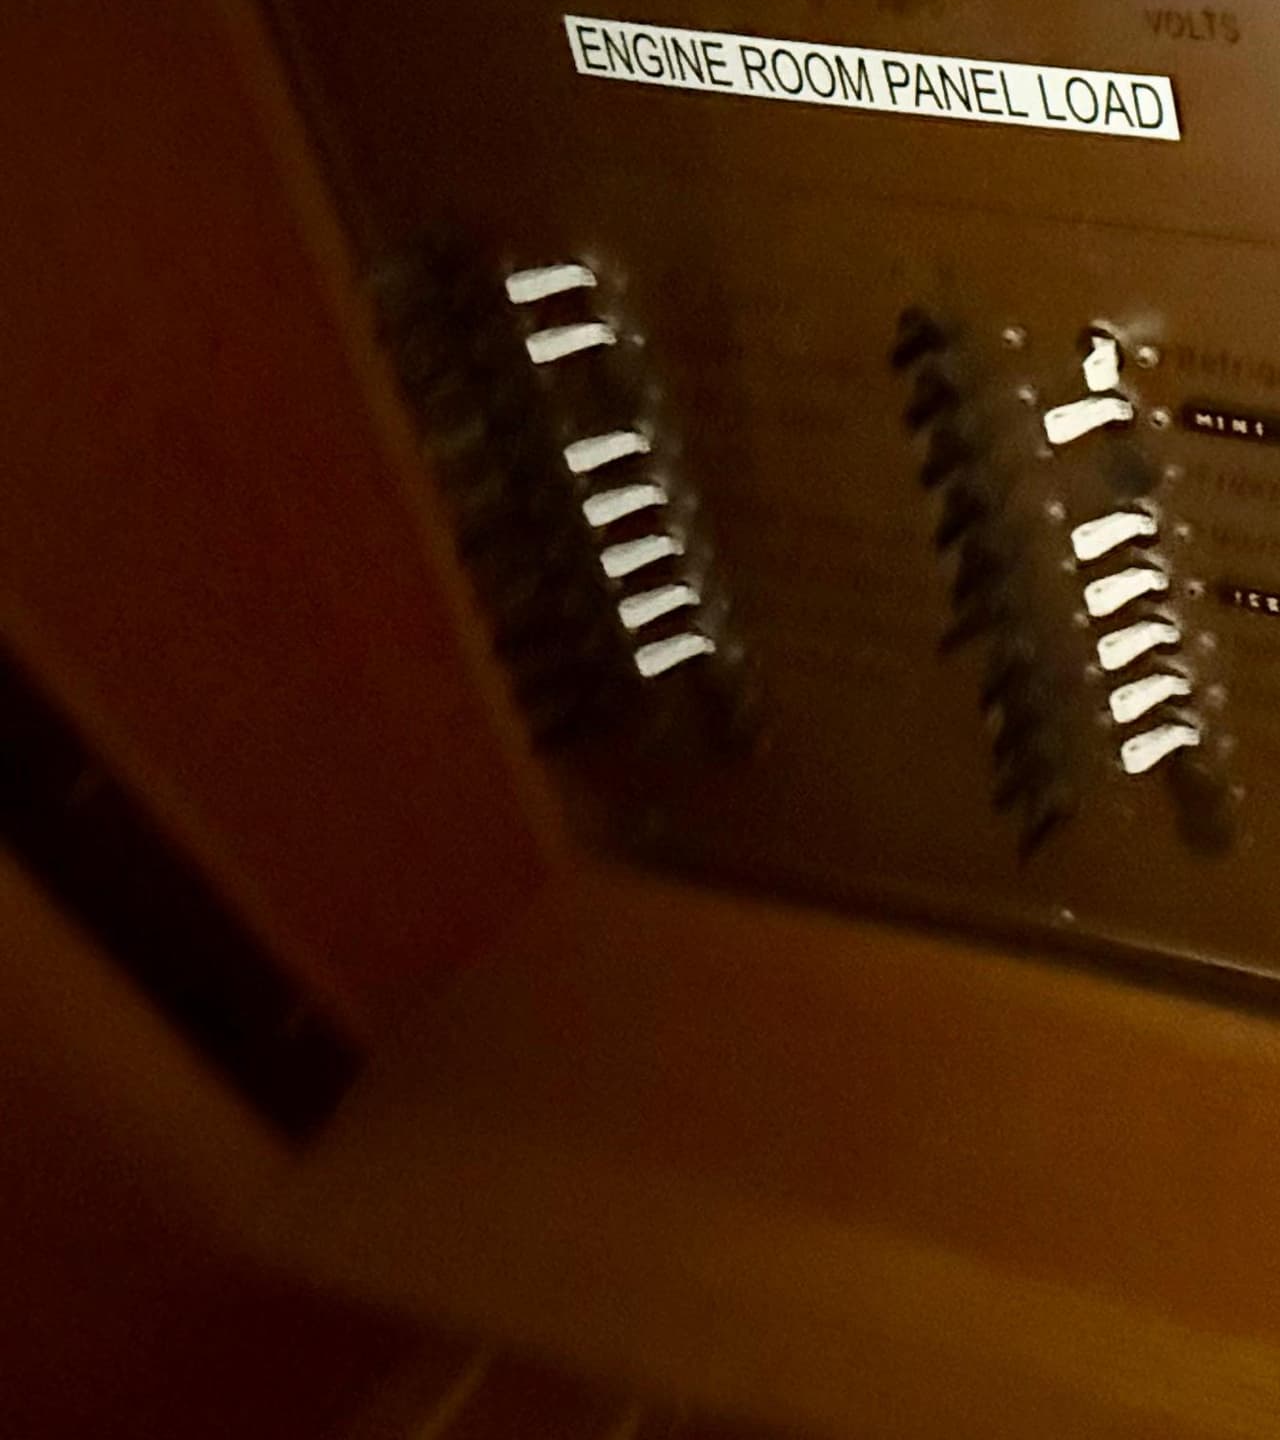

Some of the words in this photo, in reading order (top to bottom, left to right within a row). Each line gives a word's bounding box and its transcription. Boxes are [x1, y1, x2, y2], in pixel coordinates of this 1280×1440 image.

[577, 24, 729, 88] ENGINE
[742, 45, 873, 104] ROOM
[887, 61, 1032, 118] PANEL
[1040, 74, 1165, 131] LOAD
[1196, 414, 1263, 436] MINI
